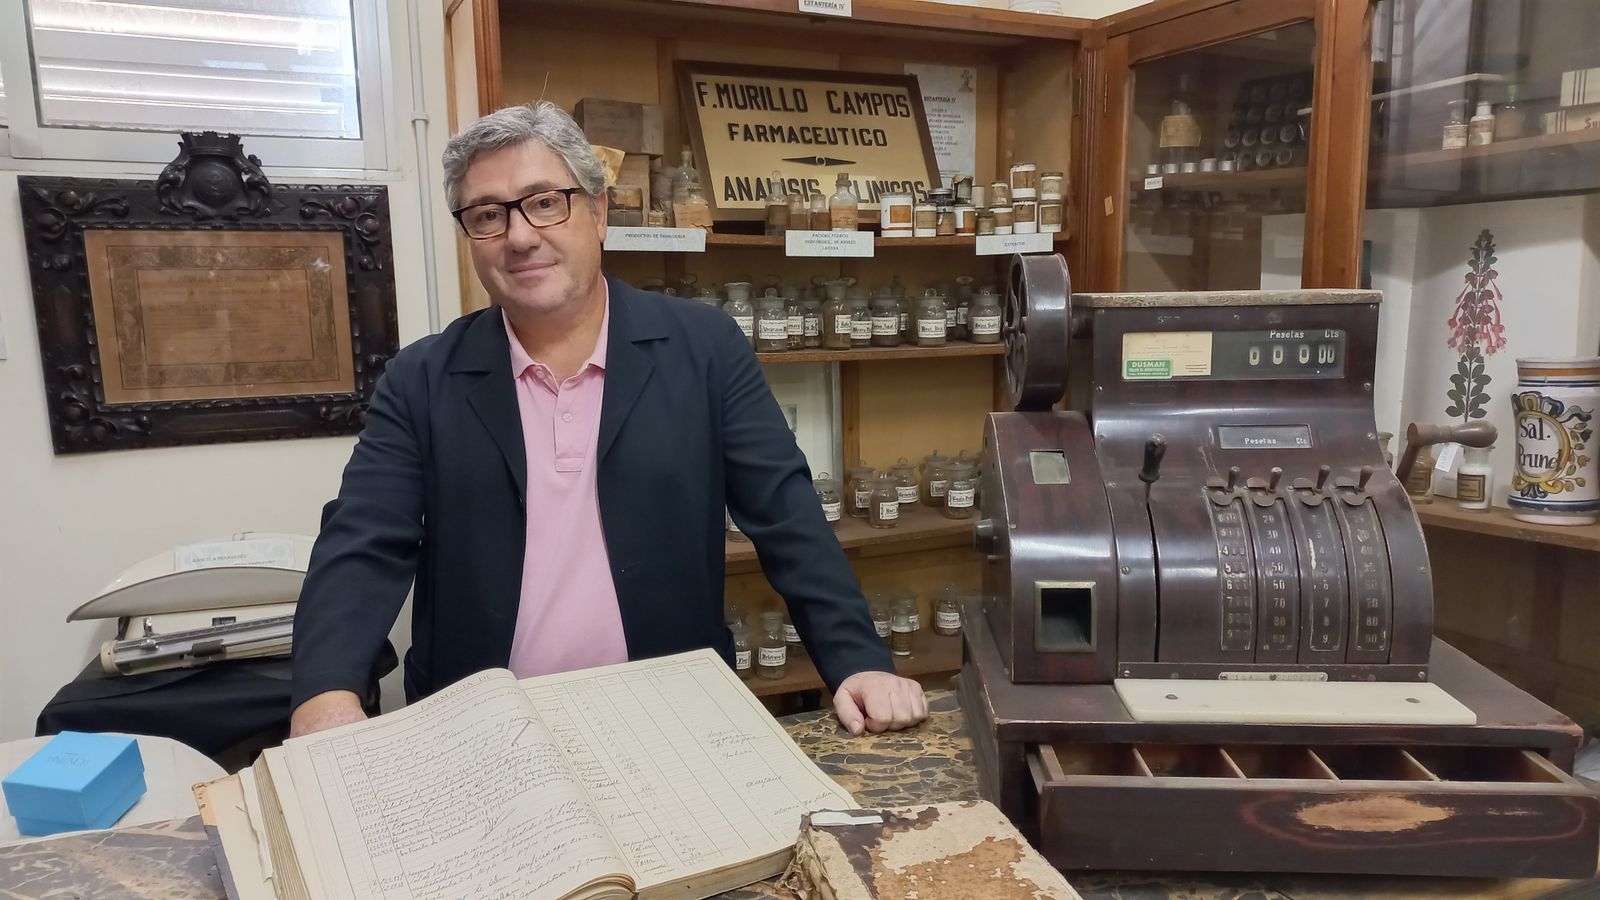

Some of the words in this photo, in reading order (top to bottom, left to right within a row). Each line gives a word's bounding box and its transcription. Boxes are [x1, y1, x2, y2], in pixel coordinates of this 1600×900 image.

[826, 90, 911, 118] CAMPOS
[727, 122, 888, 147] FARMACEUTICO
[1269, 329, 1305, 339] Pesetas
[1324, 328, 1339, 338] Cts
[1249, 346, 1260, 366] 0
[1273, 345, 1284, 365] 0
[1299, 344, 1310, 364] 0
[1520, 417, 1551, 440] Sal.
[1244, 437, 1277, 445] Pesetas
[1322, 633, 1329, 644] 9
